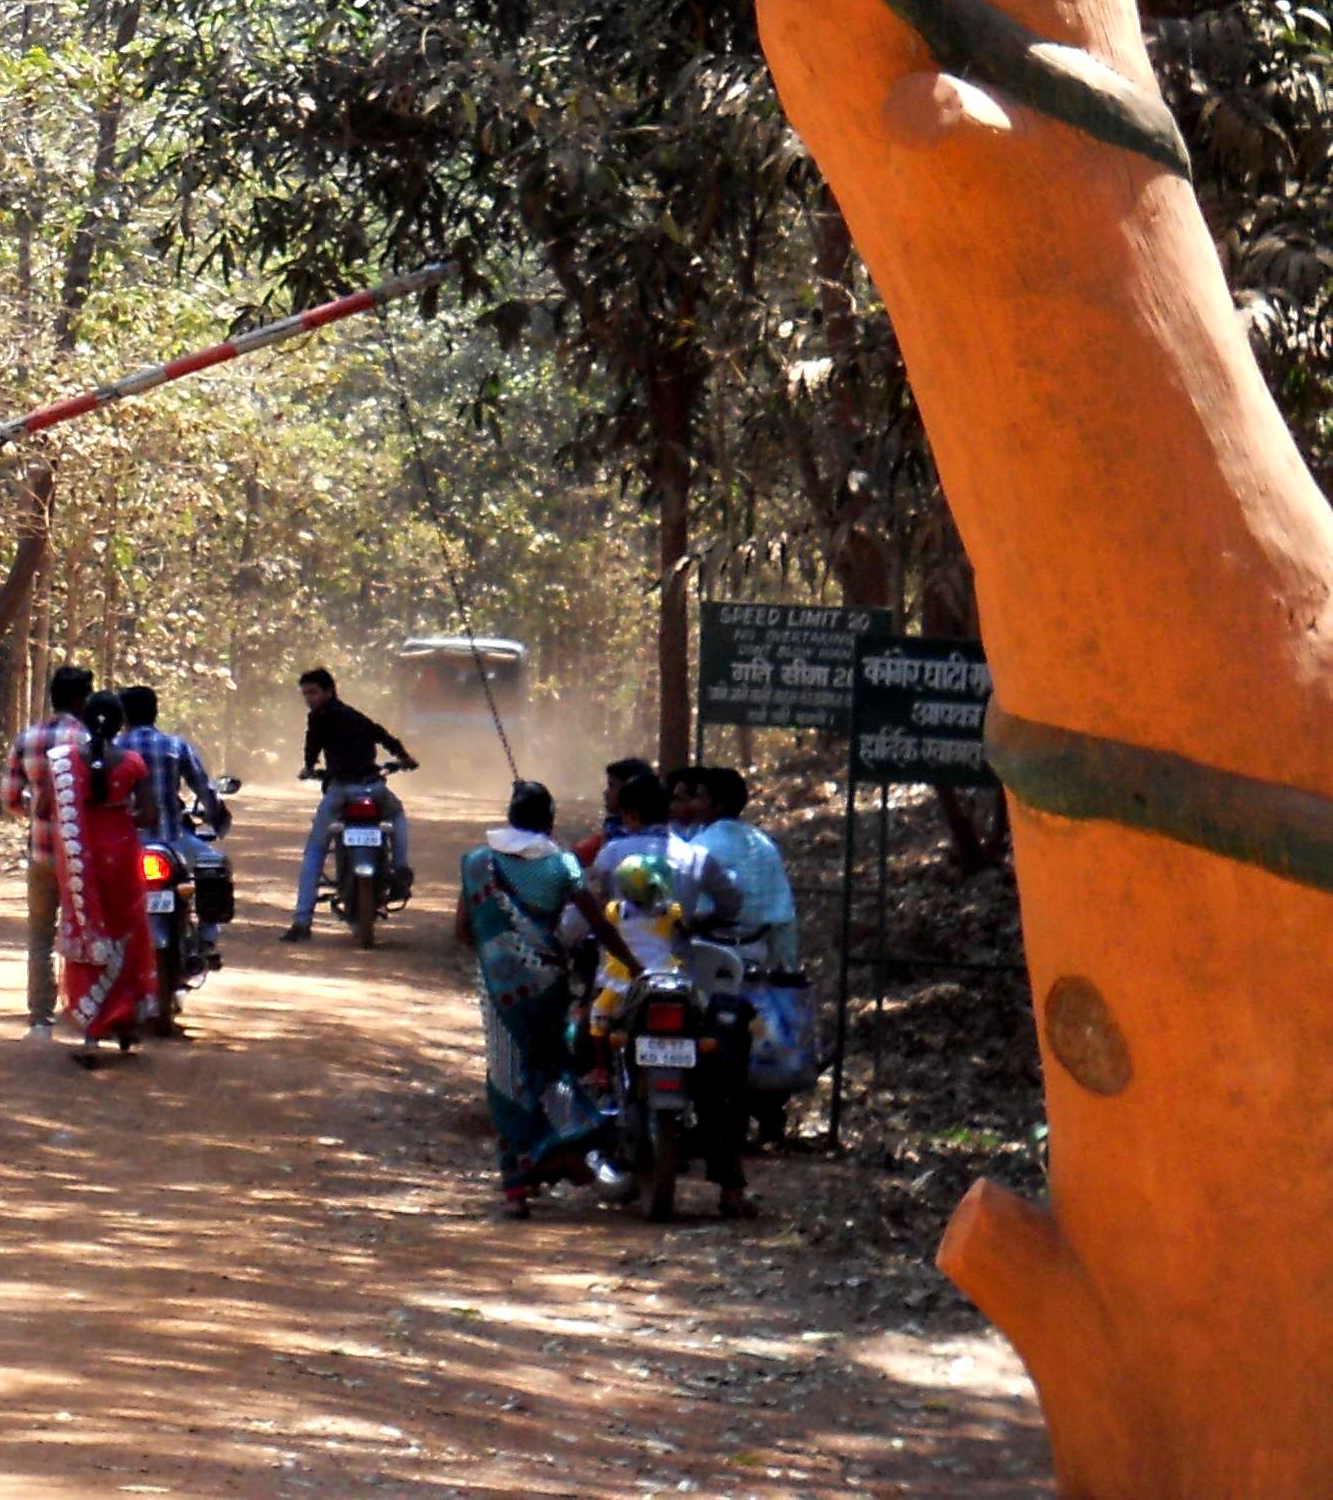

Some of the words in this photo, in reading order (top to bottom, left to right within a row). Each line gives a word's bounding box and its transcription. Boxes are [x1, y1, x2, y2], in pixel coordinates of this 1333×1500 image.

[719, 606, 781, 626] SPEED
[787, 609, 843, 628] LIMIT
[847, 612, 871, 631] 20
